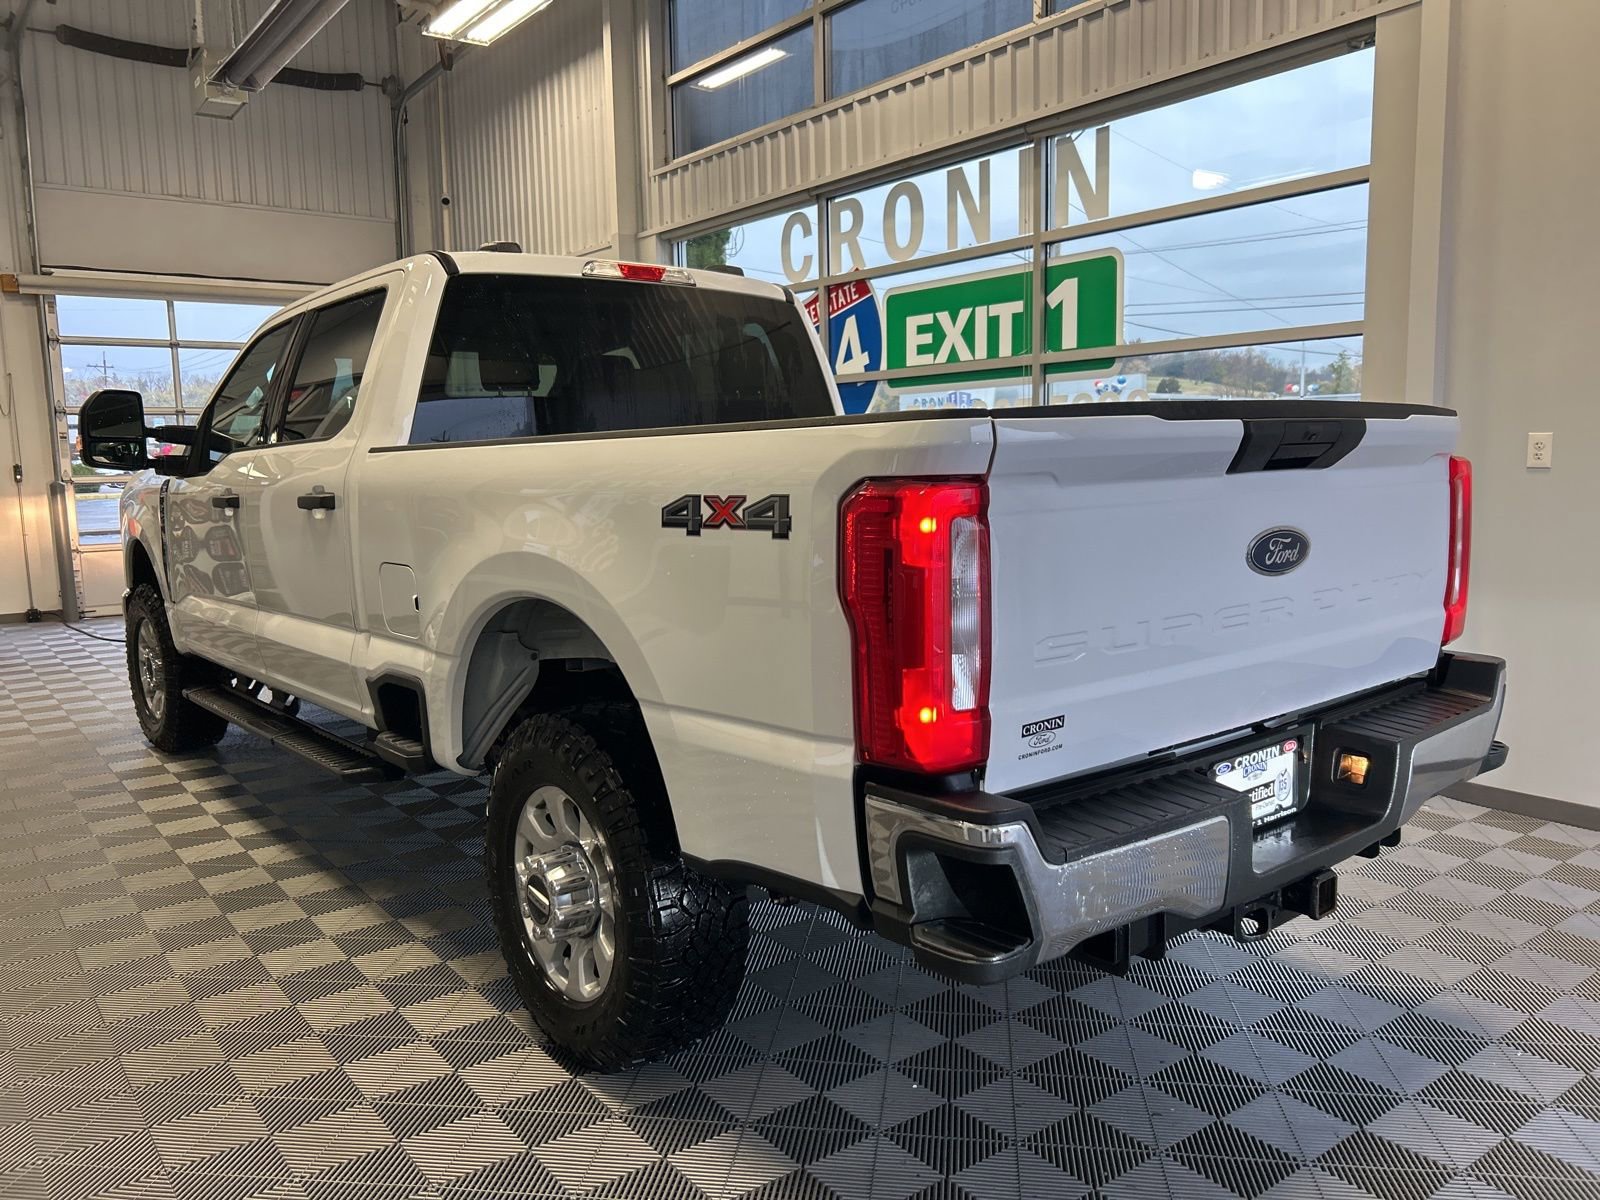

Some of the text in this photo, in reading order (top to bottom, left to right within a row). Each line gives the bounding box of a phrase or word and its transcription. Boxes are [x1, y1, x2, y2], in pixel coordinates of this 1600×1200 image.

[781, 124, 1110, 284] CRONIN
[906, 277, 1078, 367] EXIT 1
[1265, 537, 1301, 566] Ford
[1034, 568, 1434, 668] SUPER DUTY
[1023, 717, 1063, 736] CRONIN
[1018, 744, 1063, 760] CRONINFORD.COM
[1235, 745, 1279, 769] CRONIN
[1249, 783, 1274, 802] tified
